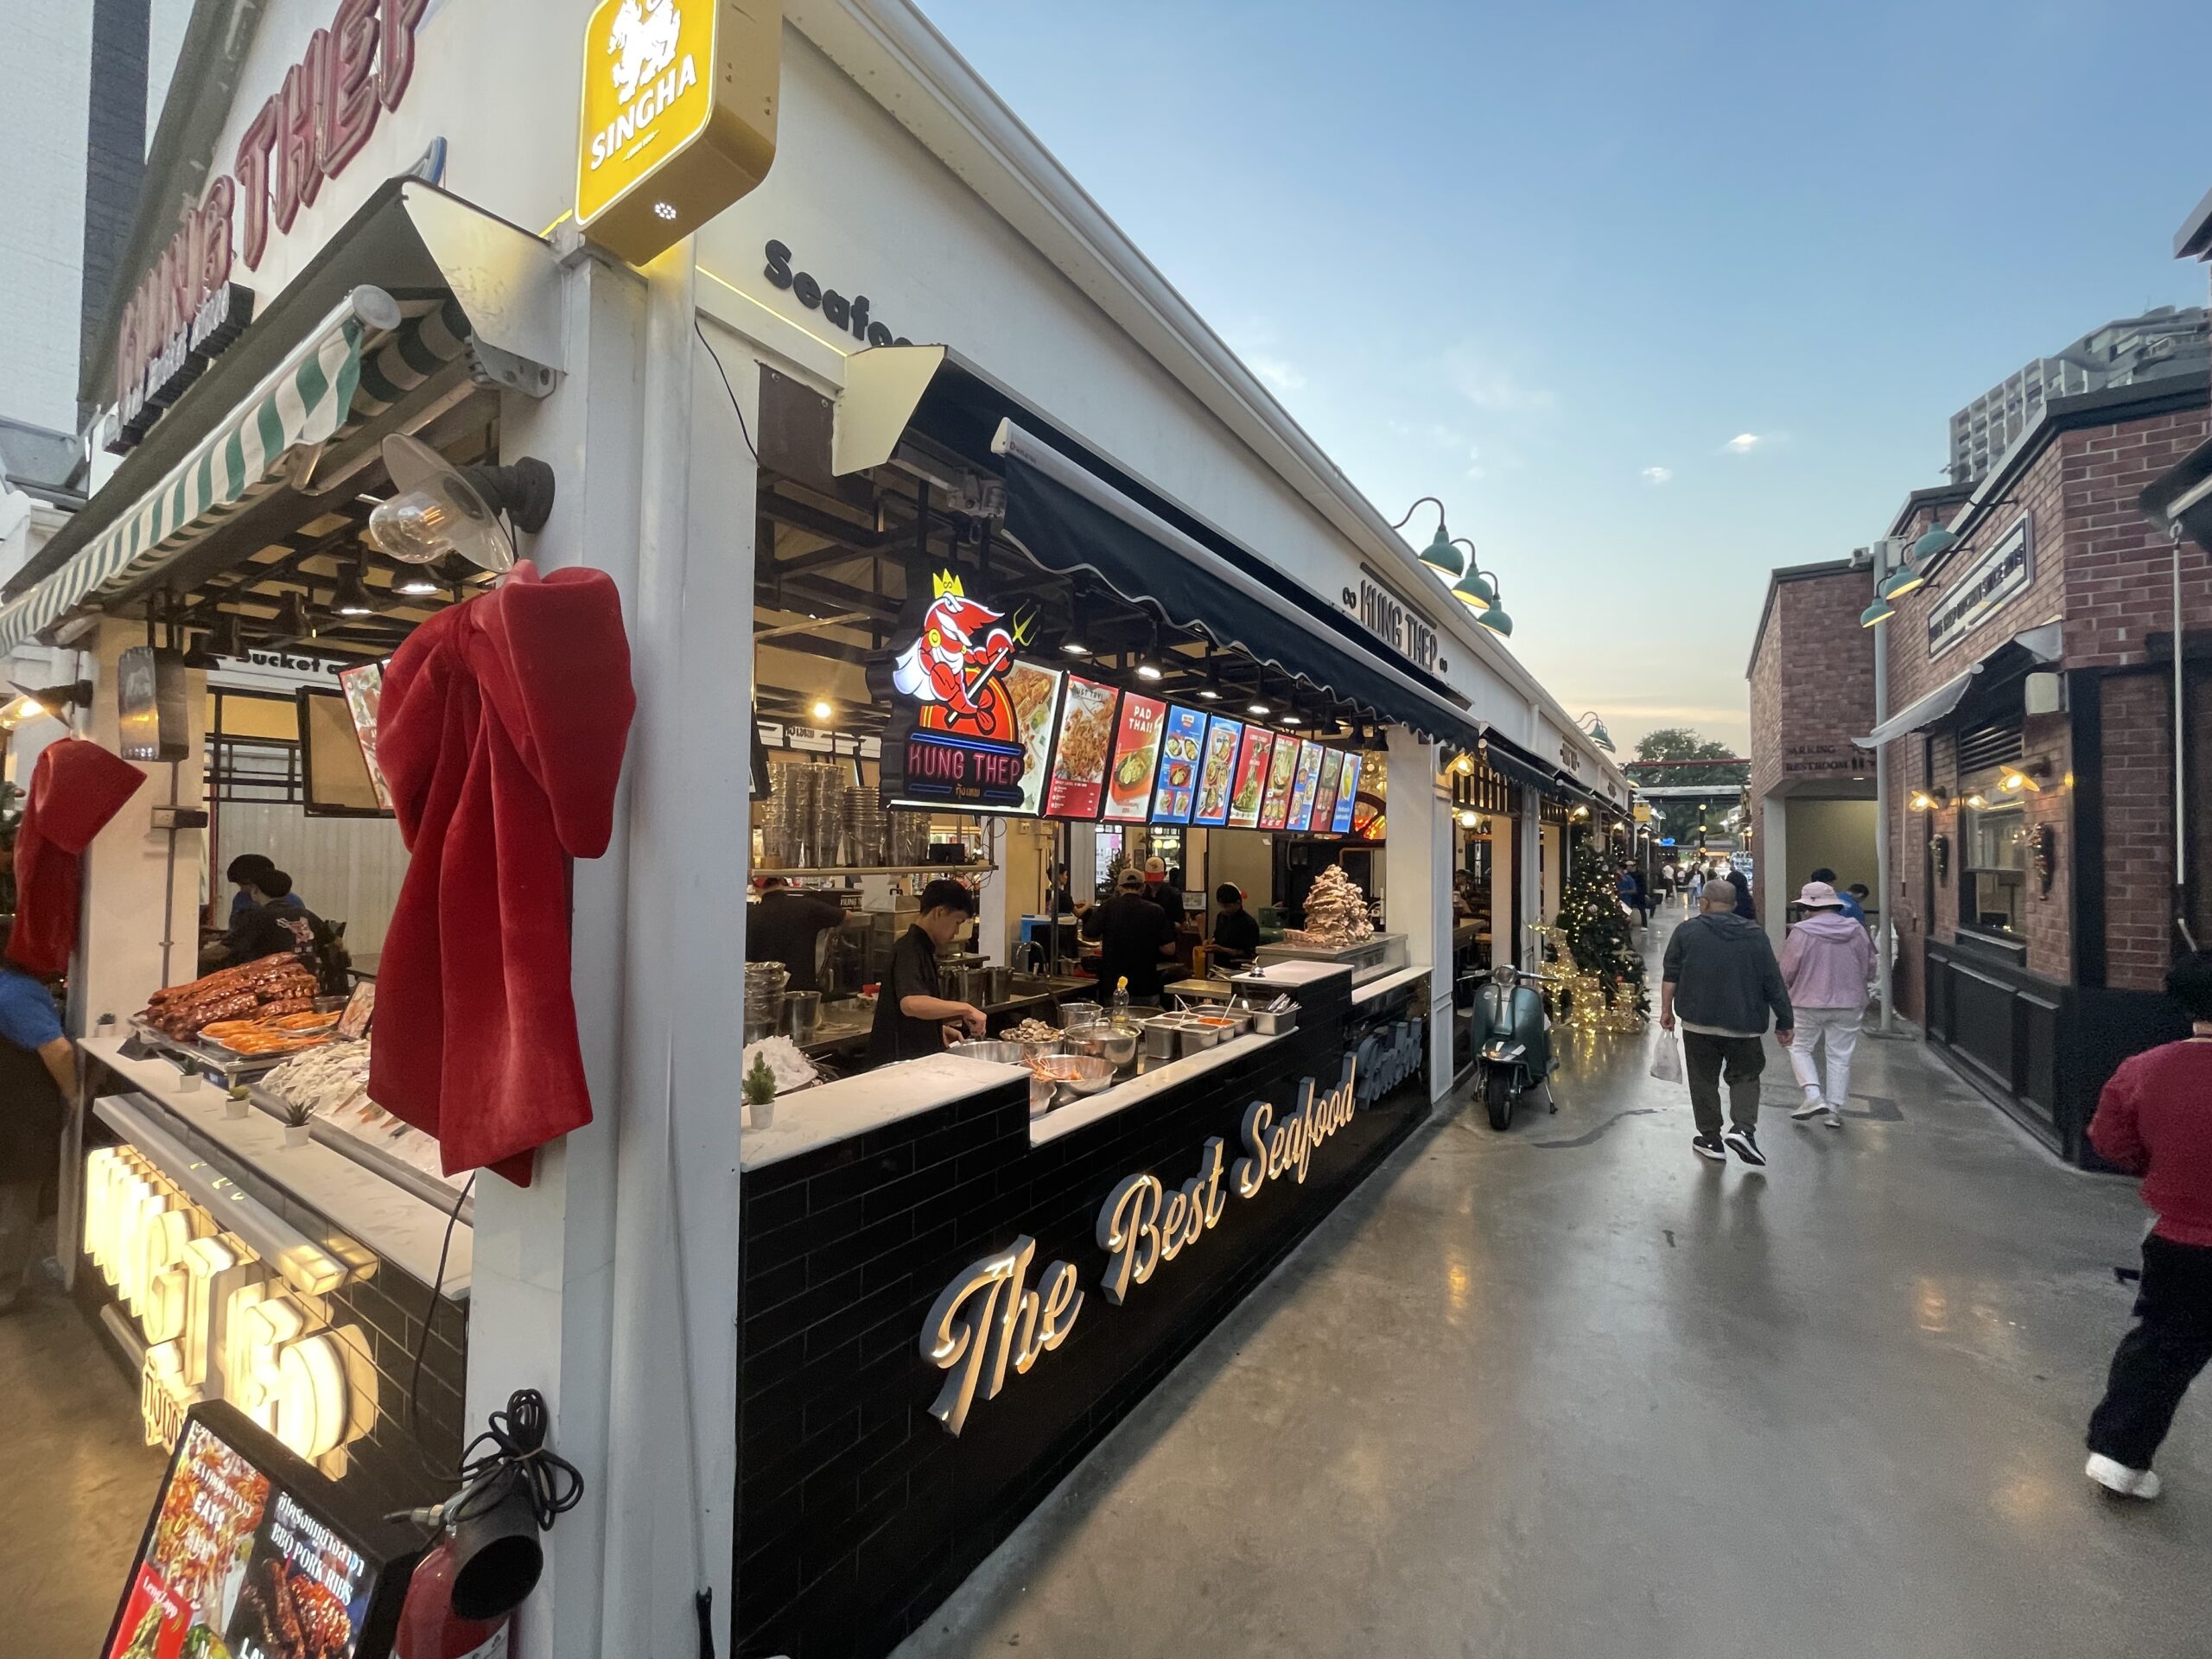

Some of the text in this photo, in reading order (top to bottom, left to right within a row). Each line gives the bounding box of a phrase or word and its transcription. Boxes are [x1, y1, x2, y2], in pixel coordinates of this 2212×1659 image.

[591, 54, 697, 171] SINGHA
[764, 239, 913, 346] Seafo
[1361, 580, 1438, 671] KUNG THEP
[1128, 718, 1154, 734] THAI!
[1134, 705, 1152, 720] PAD
[909, 743, 1021, 785] KUNG THEP
[1785, 745, 1836, 756] PARKING
[1785, 760, 1848, 772] RESTROOM
[919, 1234, 1084, 1438] The
[1096, 1137, 1225, 1306] Best
[1230, 1052, 1356, 1198] Seafood
[270, 1522, 353, 1606] BBQ PORK RIBS
